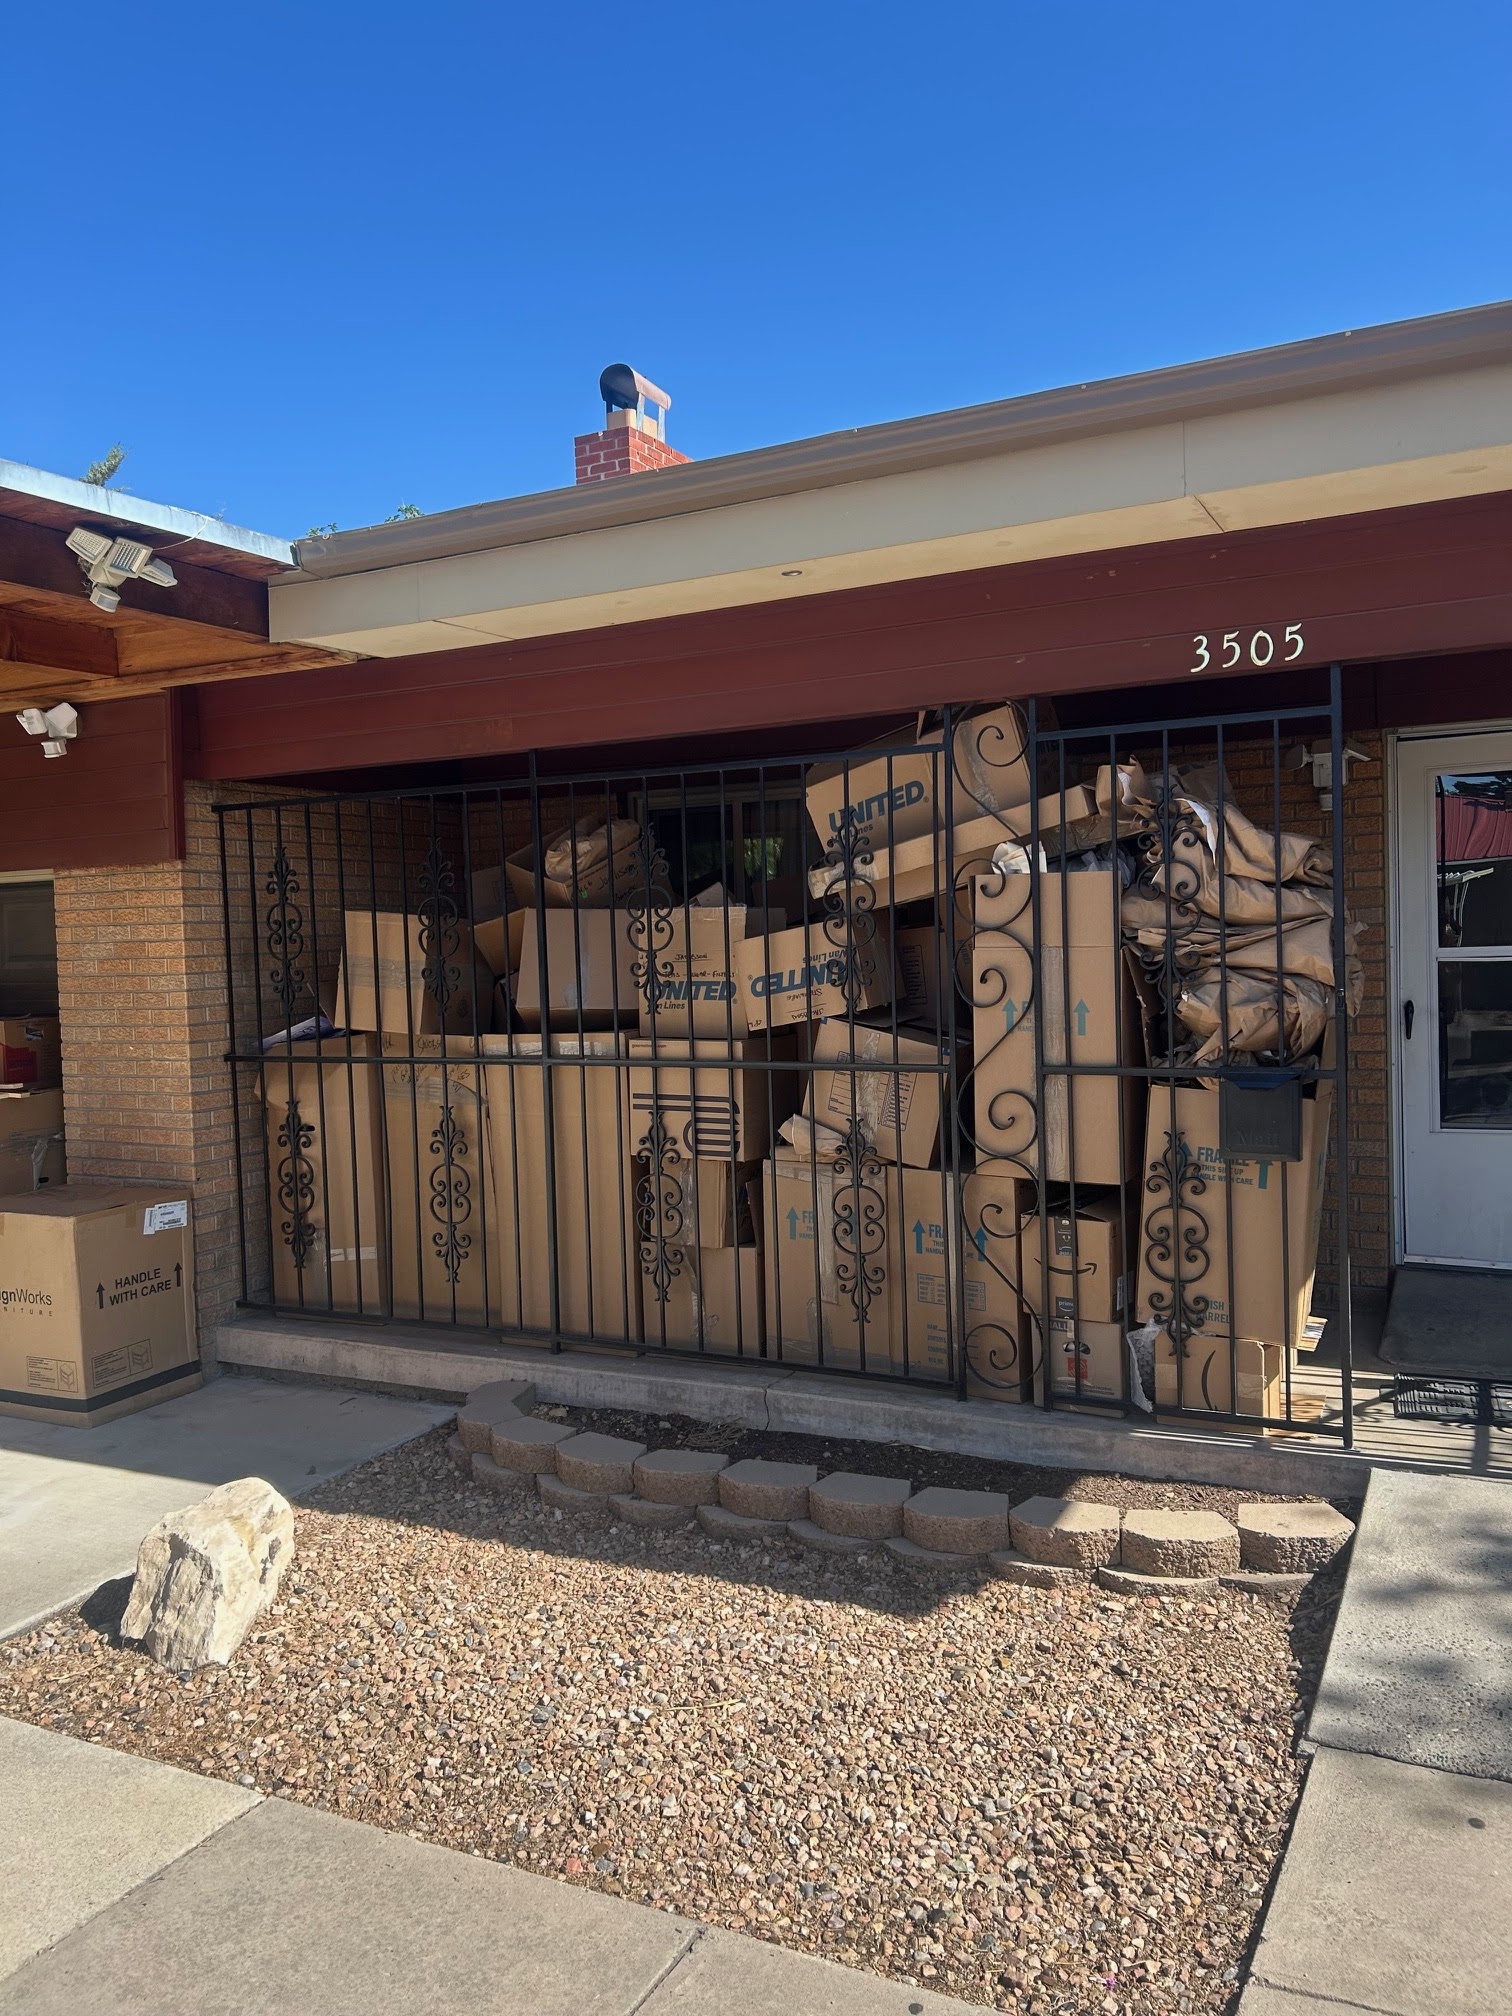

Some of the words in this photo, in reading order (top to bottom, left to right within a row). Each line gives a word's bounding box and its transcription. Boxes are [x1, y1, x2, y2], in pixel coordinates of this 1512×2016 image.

[1190, 622, 1304, 673] 3505
[829, 780, 925, 833] UNITED
[751, 960, 846, 998] UNITED
[652, 981, 738, 1000] UNITED
[664, 1001, 685, 1010] Lines
[1218, 1167, 1233, 1175] SIE
[1236, 1177, 1254, 1186] CARE
[115, 1268, 161, 1290] HANDLE
[0, 1287, 53, 1306] gnWorks
[109, 1289, 138, 1306] WITH
[141, 1280, 172, 1297] CARE
[1209, 1300, 1225, 1311] ISH
[1201, 1311, 1230, 1324] ARREL
